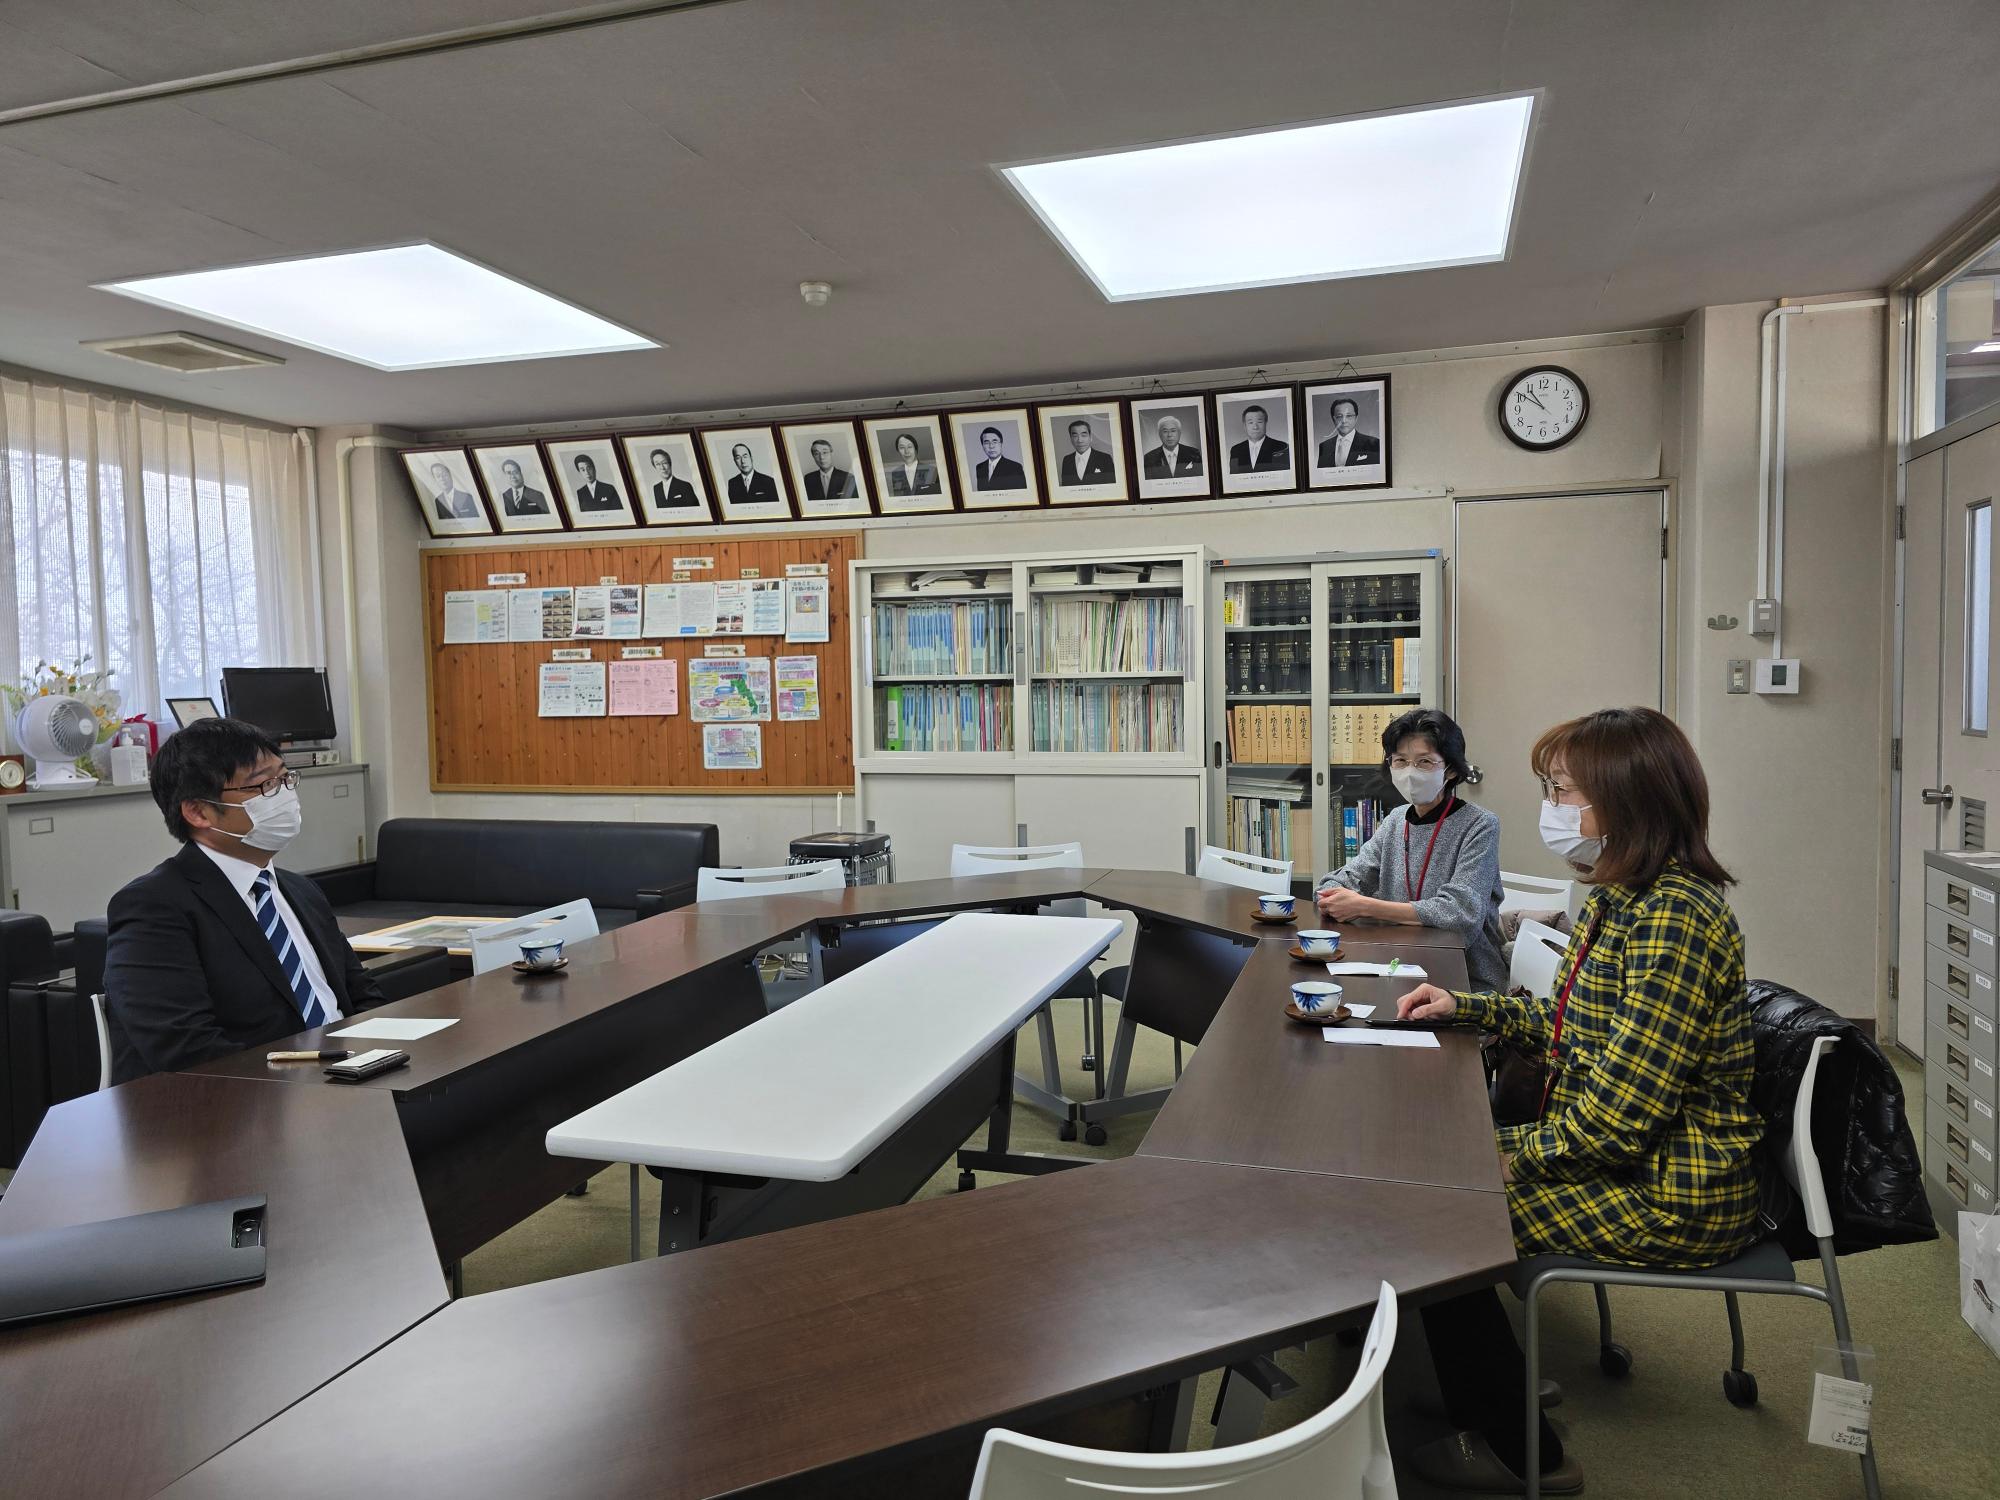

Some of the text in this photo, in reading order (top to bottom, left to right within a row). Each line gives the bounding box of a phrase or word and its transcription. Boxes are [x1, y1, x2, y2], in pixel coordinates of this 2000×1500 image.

[1527, 384, 1534, 393] 11
[1539, 379, 1549, 389] 12
[1554, 381, 1558, 391] 1
[1517, 393, 1526, 402] 10
[1563, 390, 1569, 399] 2
[1514, 405, 1521, 415] 9
[1567, 401, 1573, 411] 3
[1517, 416, 1524, 426] 8
[1562, 414, 1569, 424] 4
[1527, 426, 1533, 436] 7
[1540, 427, 1546, 437] 6
[1553, 423, 1559, 433] 5
